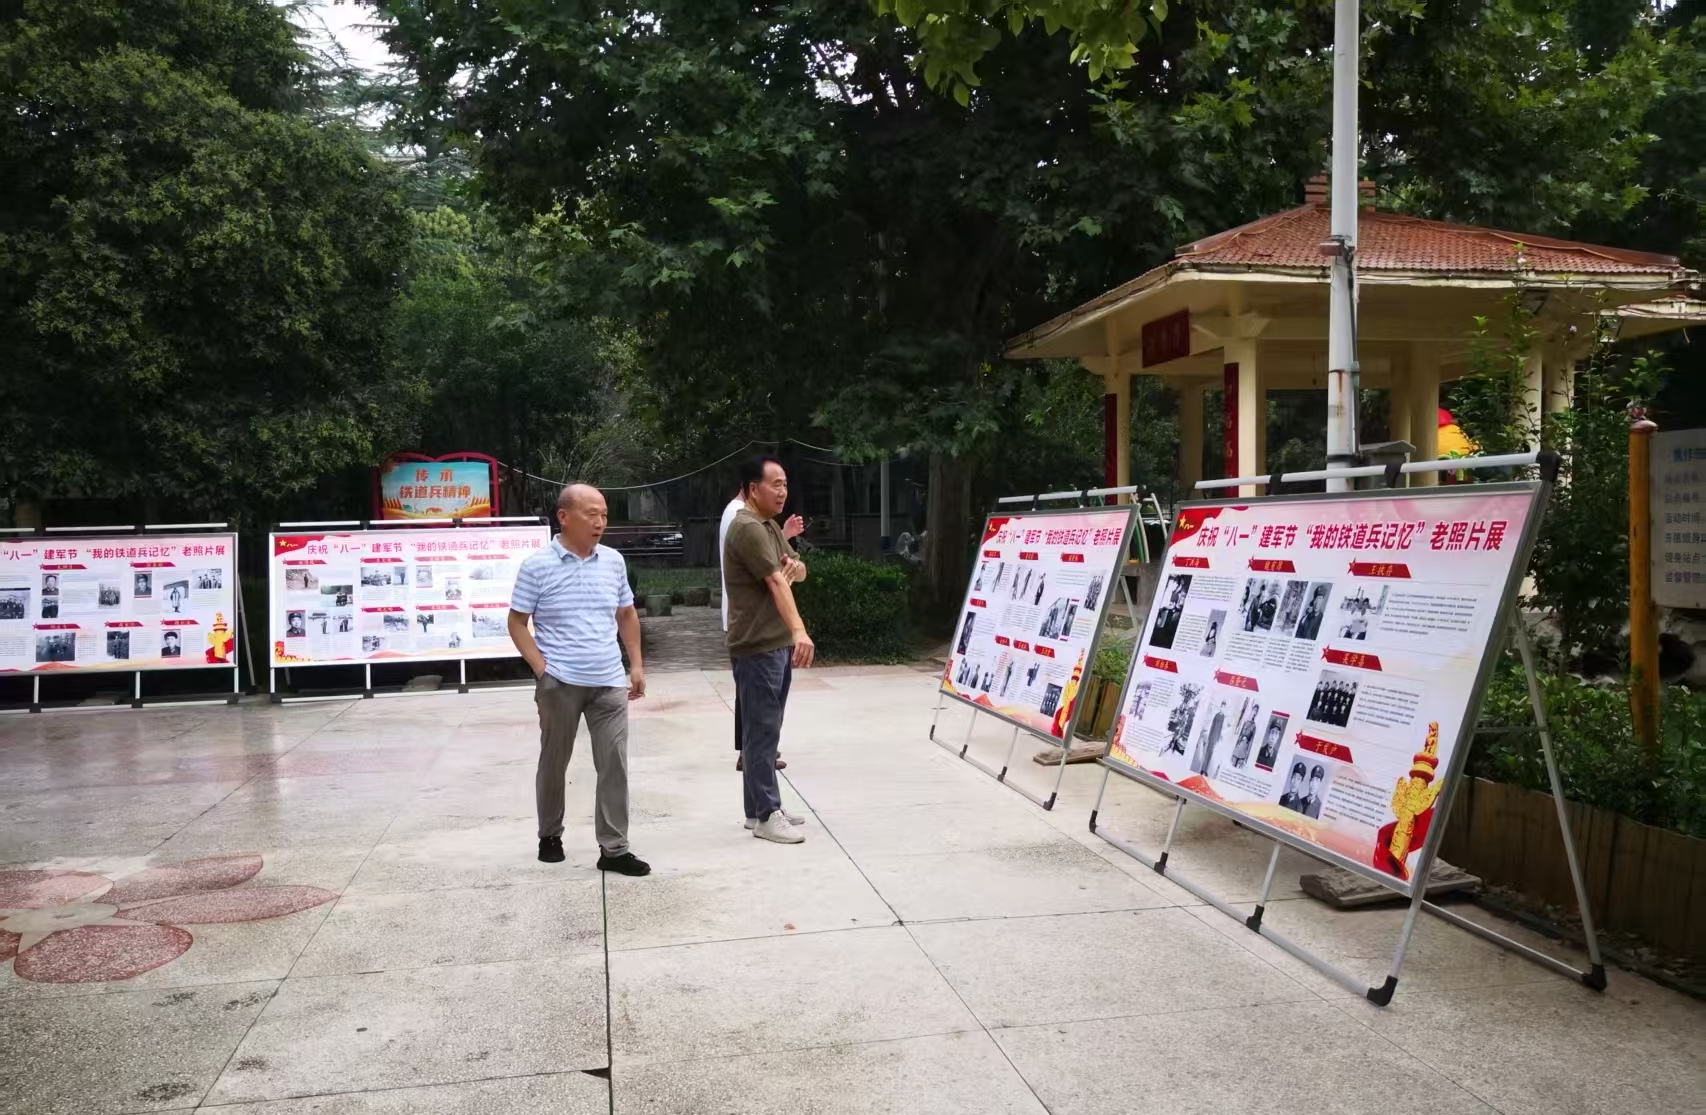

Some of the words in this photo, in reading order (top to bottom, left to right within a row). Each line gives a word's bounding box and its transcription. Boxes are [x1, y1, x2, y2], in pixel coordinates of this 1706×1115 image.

[400, 485, 471, 499] 铁道兵精神
